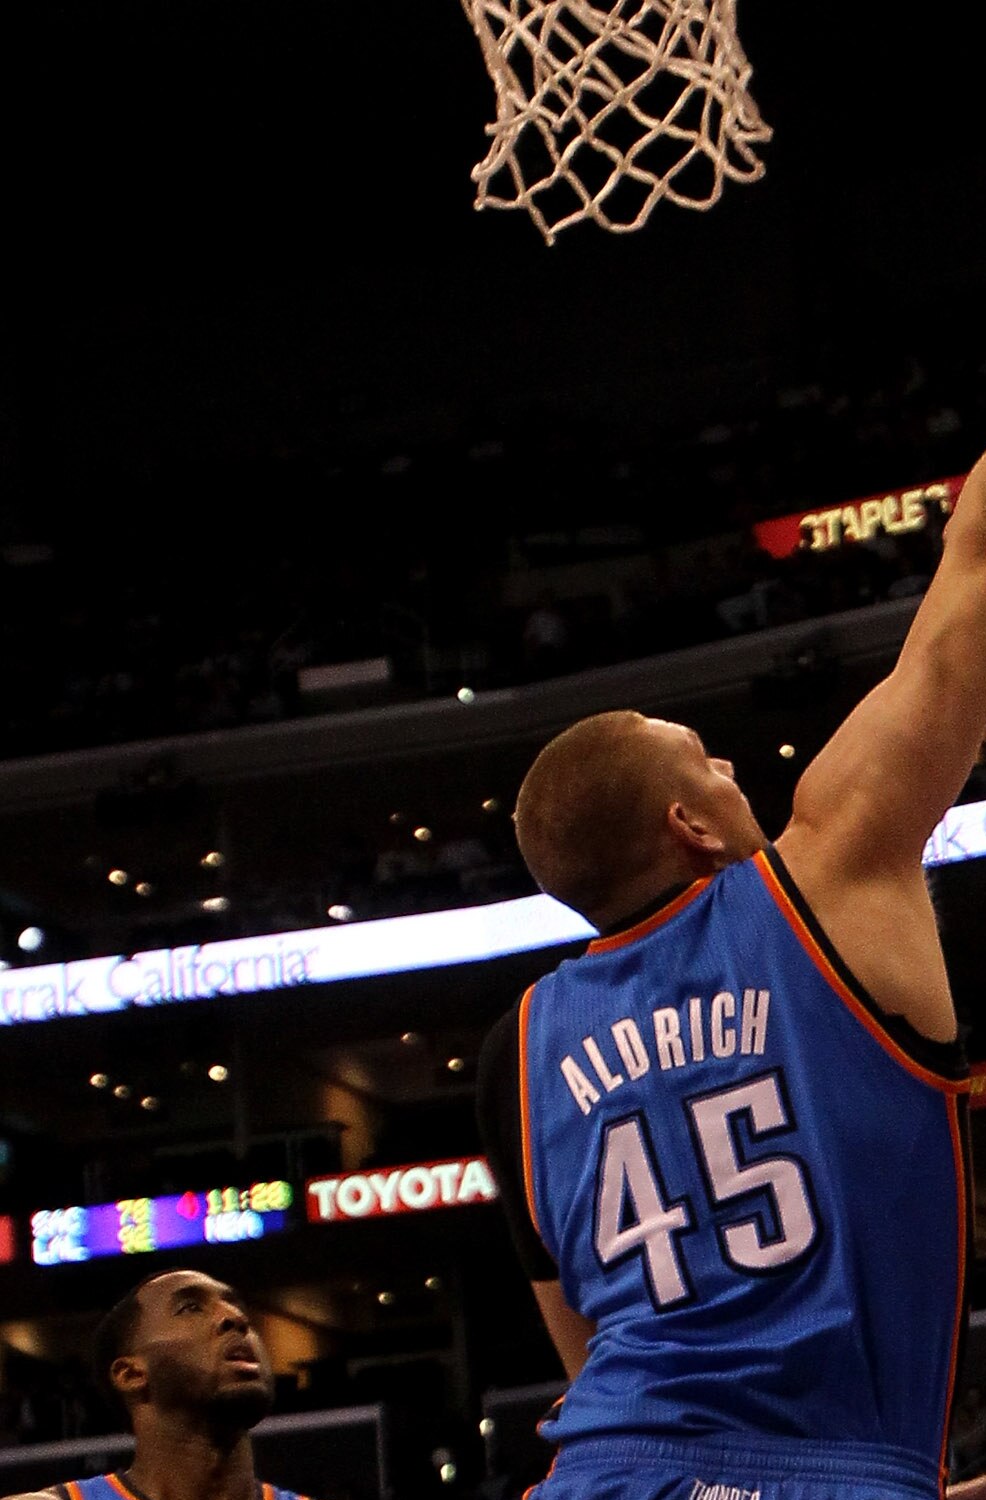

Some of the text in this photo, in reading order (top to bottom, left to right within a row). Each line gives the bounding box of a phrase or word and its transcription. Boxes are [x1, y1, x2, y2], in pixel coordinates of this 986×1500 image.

[560, 988, 771, 1116] ALDRICH
[309, 1160, 497, 1221] TOYOTA
[594, 1066, 822, 1312] 45
